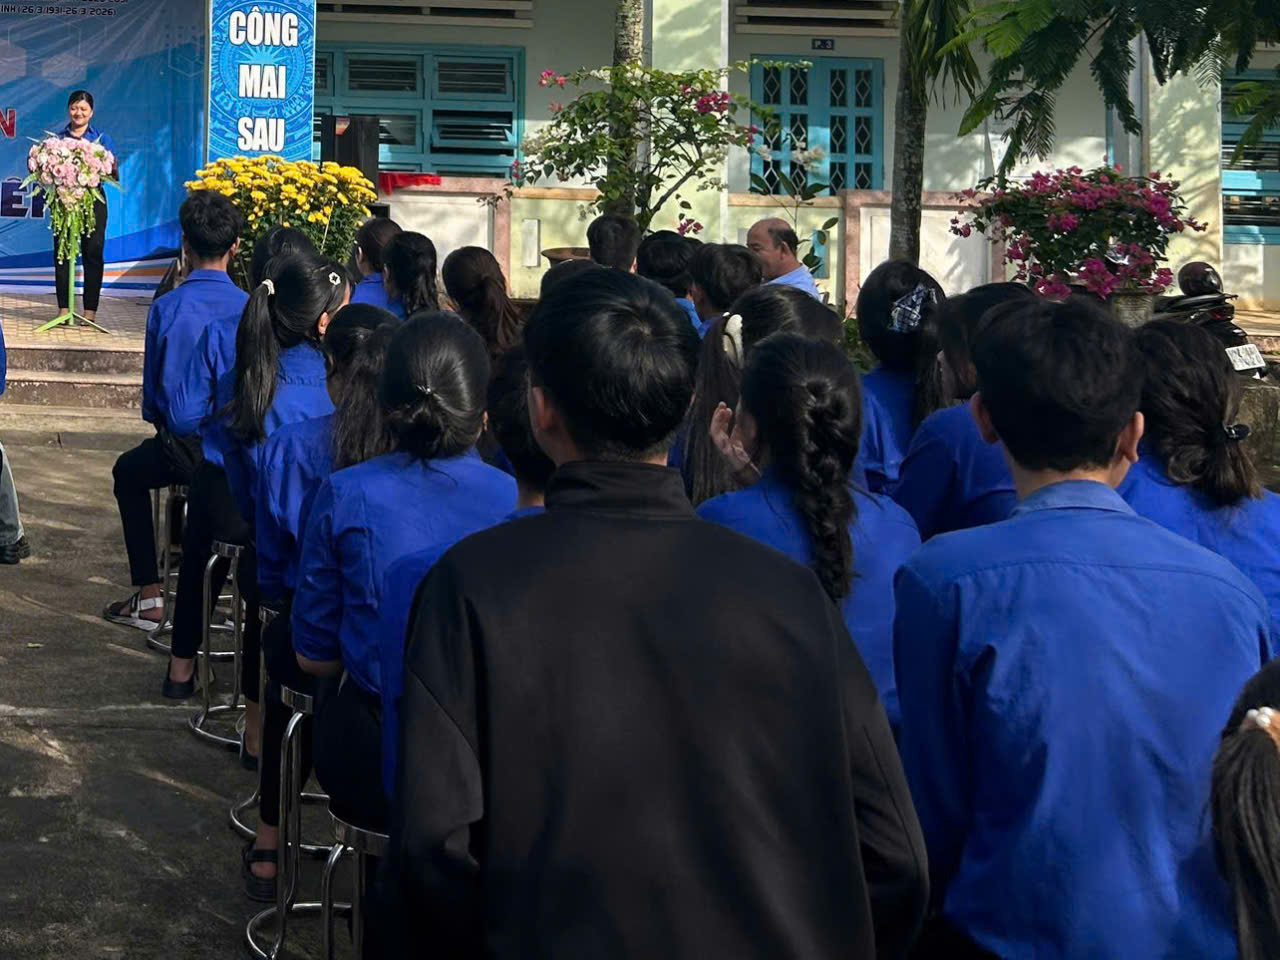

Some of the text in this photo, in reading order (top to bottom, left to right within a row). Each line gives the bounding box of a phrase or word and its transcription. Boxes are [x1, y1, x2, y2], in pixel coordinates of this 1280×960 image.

[228, 5, 299, 47] CÔNG
[238, 64, 288, 99] MAI
[236, 116, 286, 153] SAU
